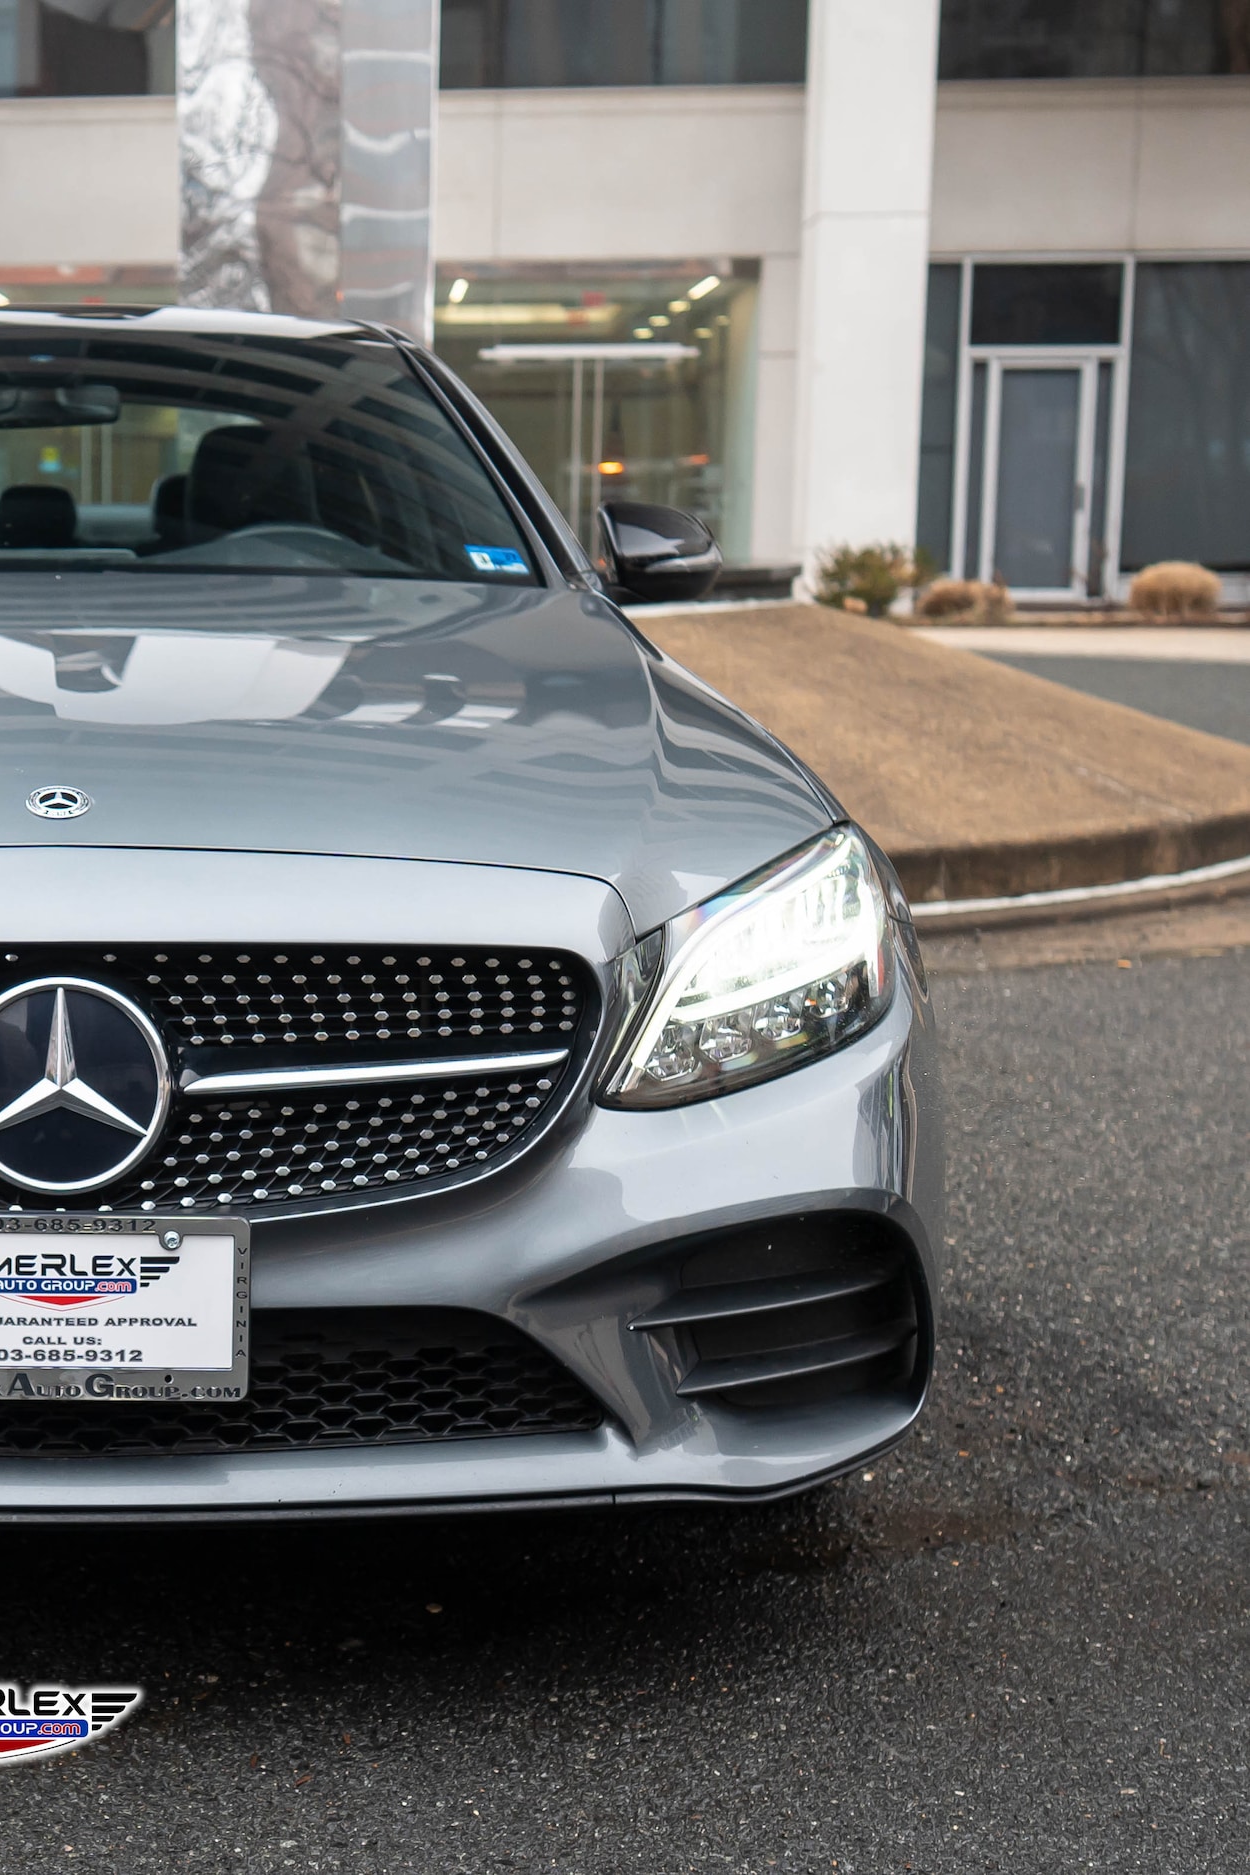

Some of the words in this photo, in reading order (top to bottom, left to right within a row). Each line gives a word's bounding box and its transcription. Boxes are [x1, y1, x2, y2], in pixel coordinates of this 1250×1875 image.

[40, 1280, 132, 1292] GROUP.com
[235, 1247, 248, 1358] VIRGINIA
[104, 1317, 198, 1327] APPROVAL
[22, 1336, 67, 1345] CALL
[73, 1337, 102, 1346] US:
